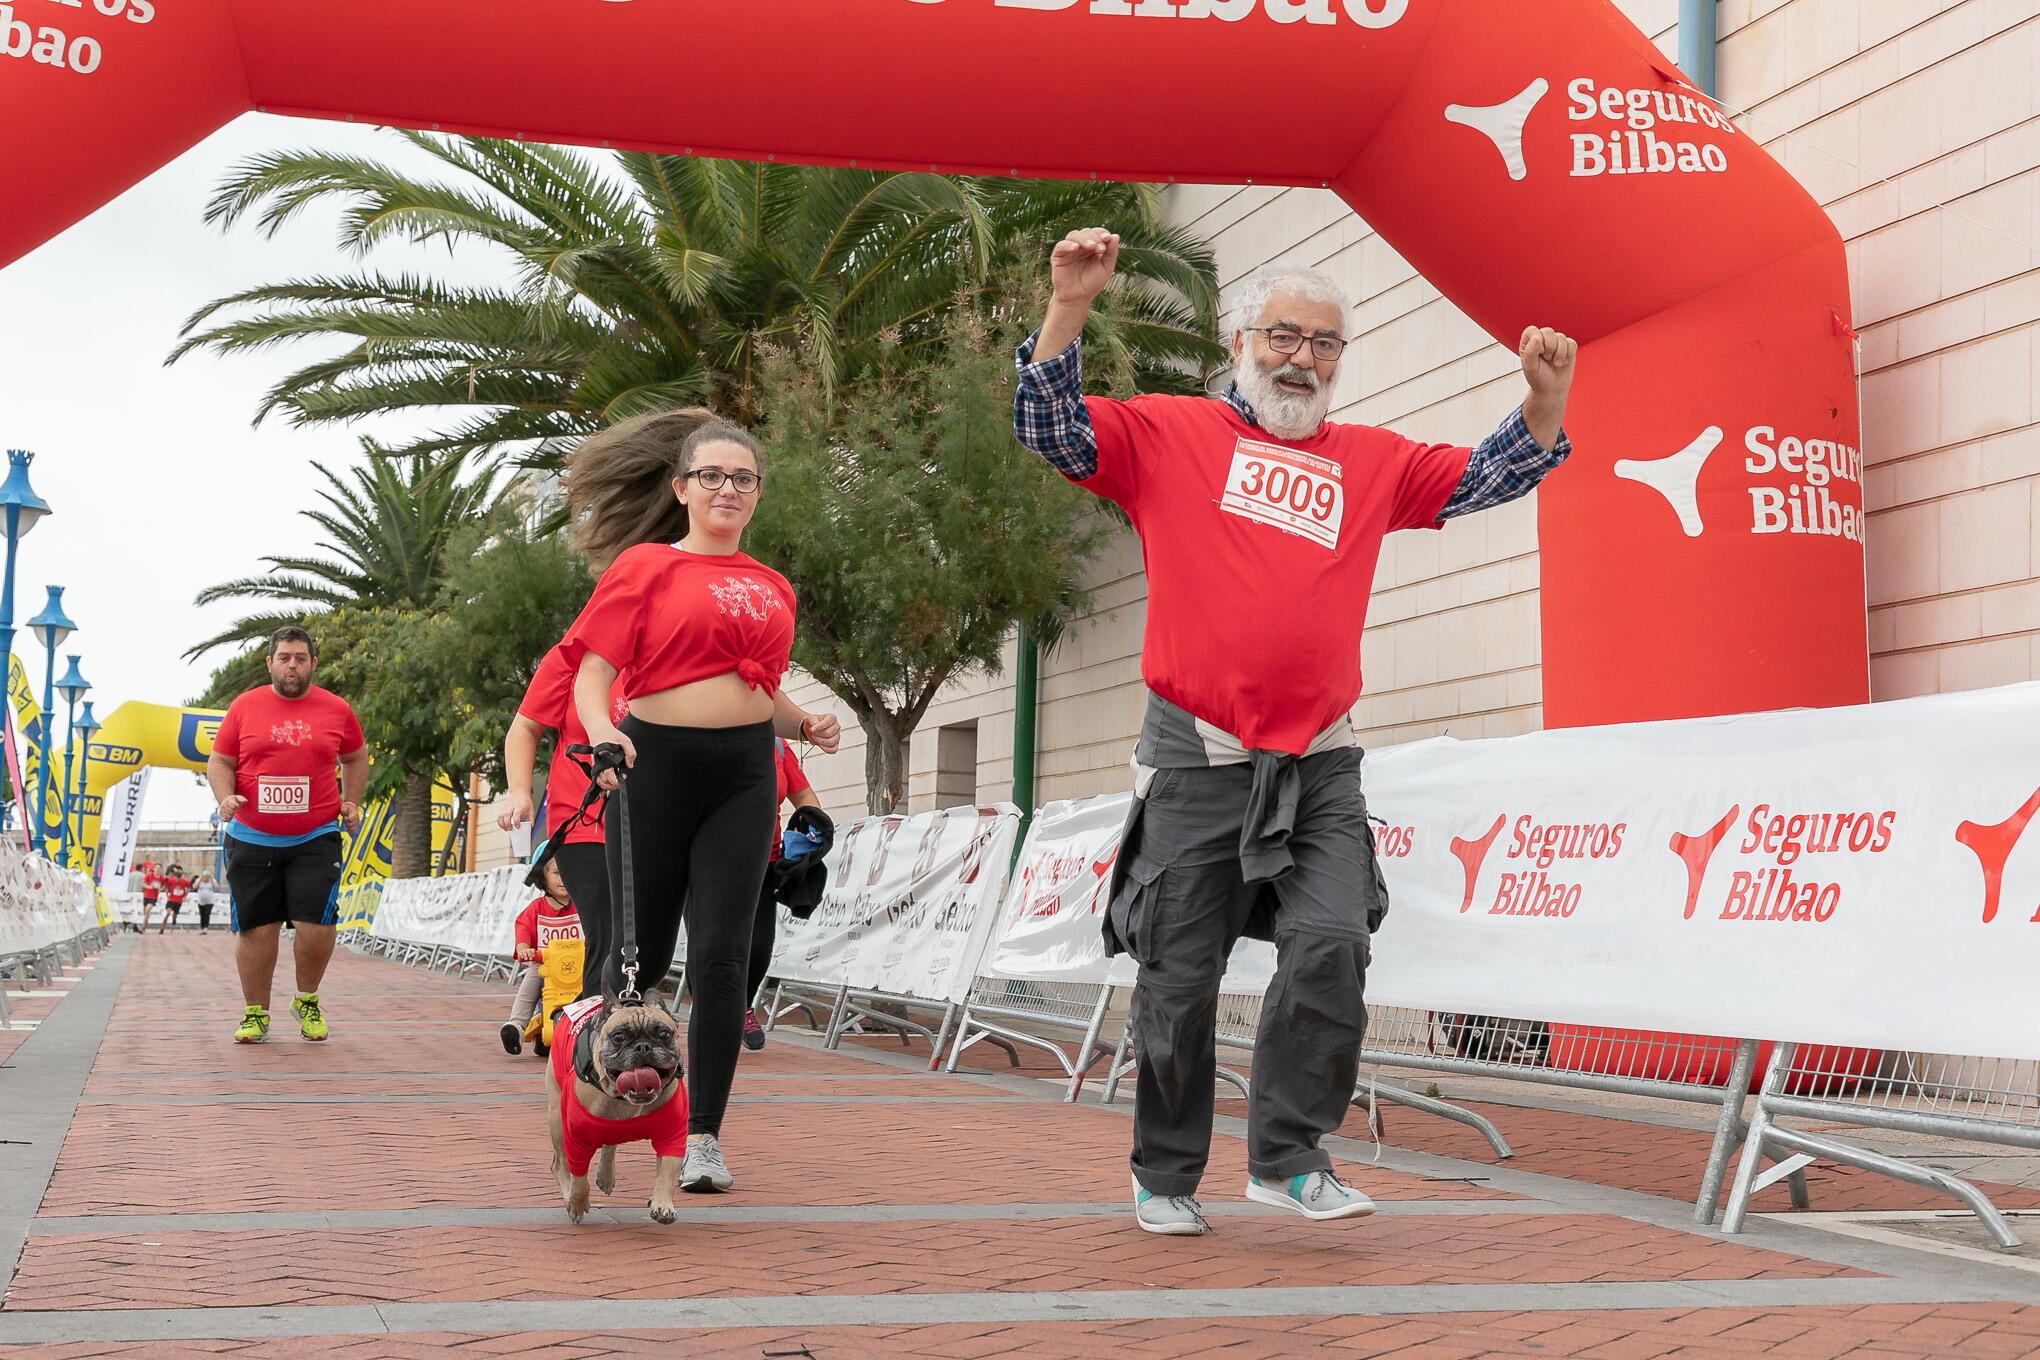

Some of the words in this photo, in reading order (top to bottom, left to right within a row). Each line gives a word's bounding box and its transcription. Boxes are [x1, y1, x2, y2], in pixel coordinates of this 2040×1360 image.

[1567, 77, 1736, 135] Seguros
[1568, 130, 1728, 177] Bilbao
[1240, 461, 1336, 521] 3009
[108, 748, 140, 764] BM
[263, 786, 304, 804] 3009
[1371, 826, 1415, 858] ros
[1507, 815, 1628, 869] Seguros
[1740, 803, 1897, 866] Seguros
[1488, 872, 1583, 918] Bilbao
[1719, 868, 1842, 923] Bilbao
